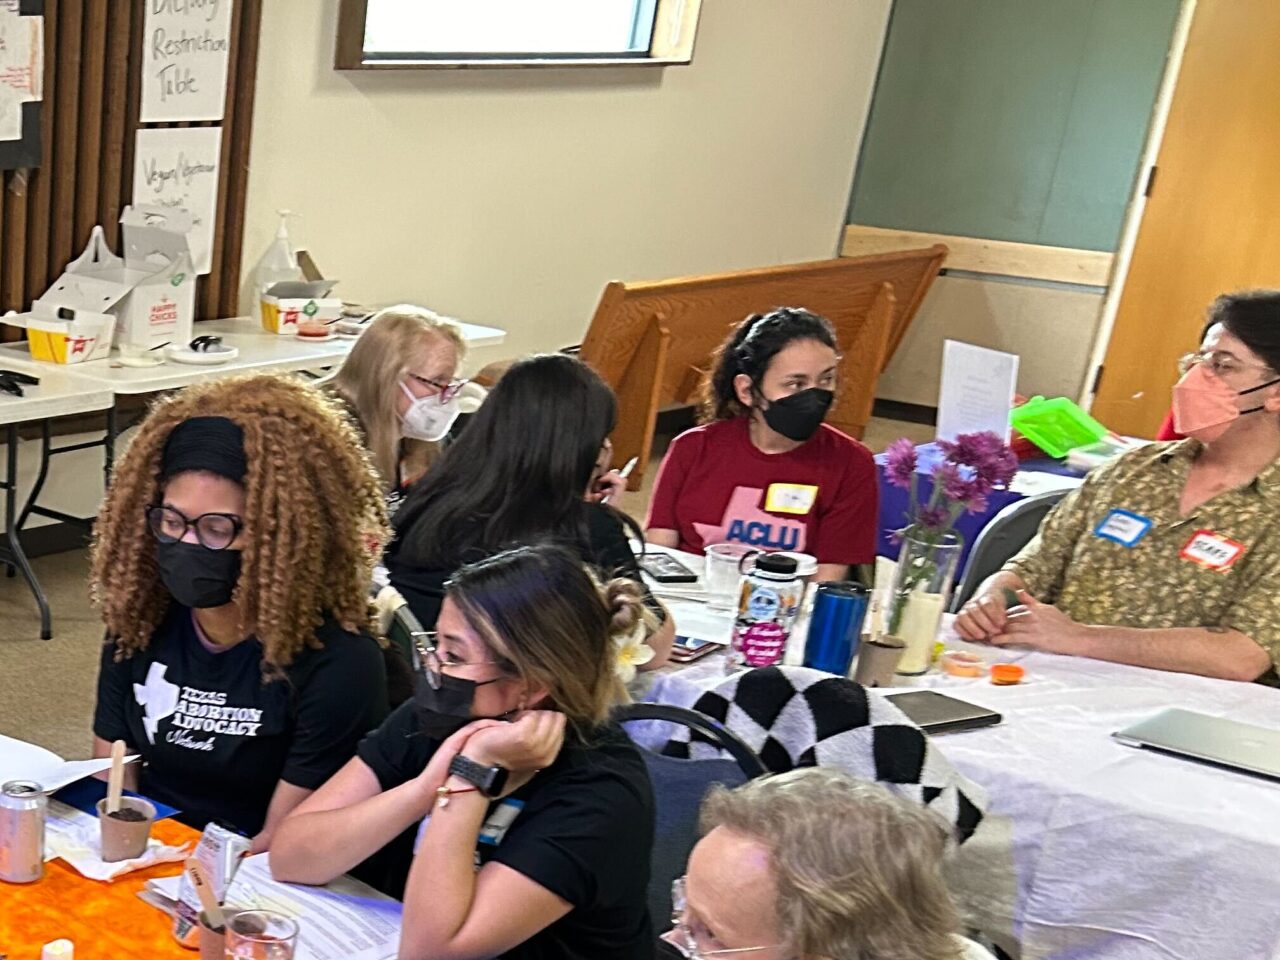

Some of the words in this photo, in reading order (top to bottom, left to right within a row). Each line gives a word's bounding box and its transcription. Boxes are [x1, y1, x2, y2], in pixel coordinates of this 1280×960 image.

[726, 519, 799, 550] ACLU
[180, 686, 227, 705] TEXAS
[175, 700, 263, 722] ABORTION
[171, 714, 263, 736] ADVOCACY
